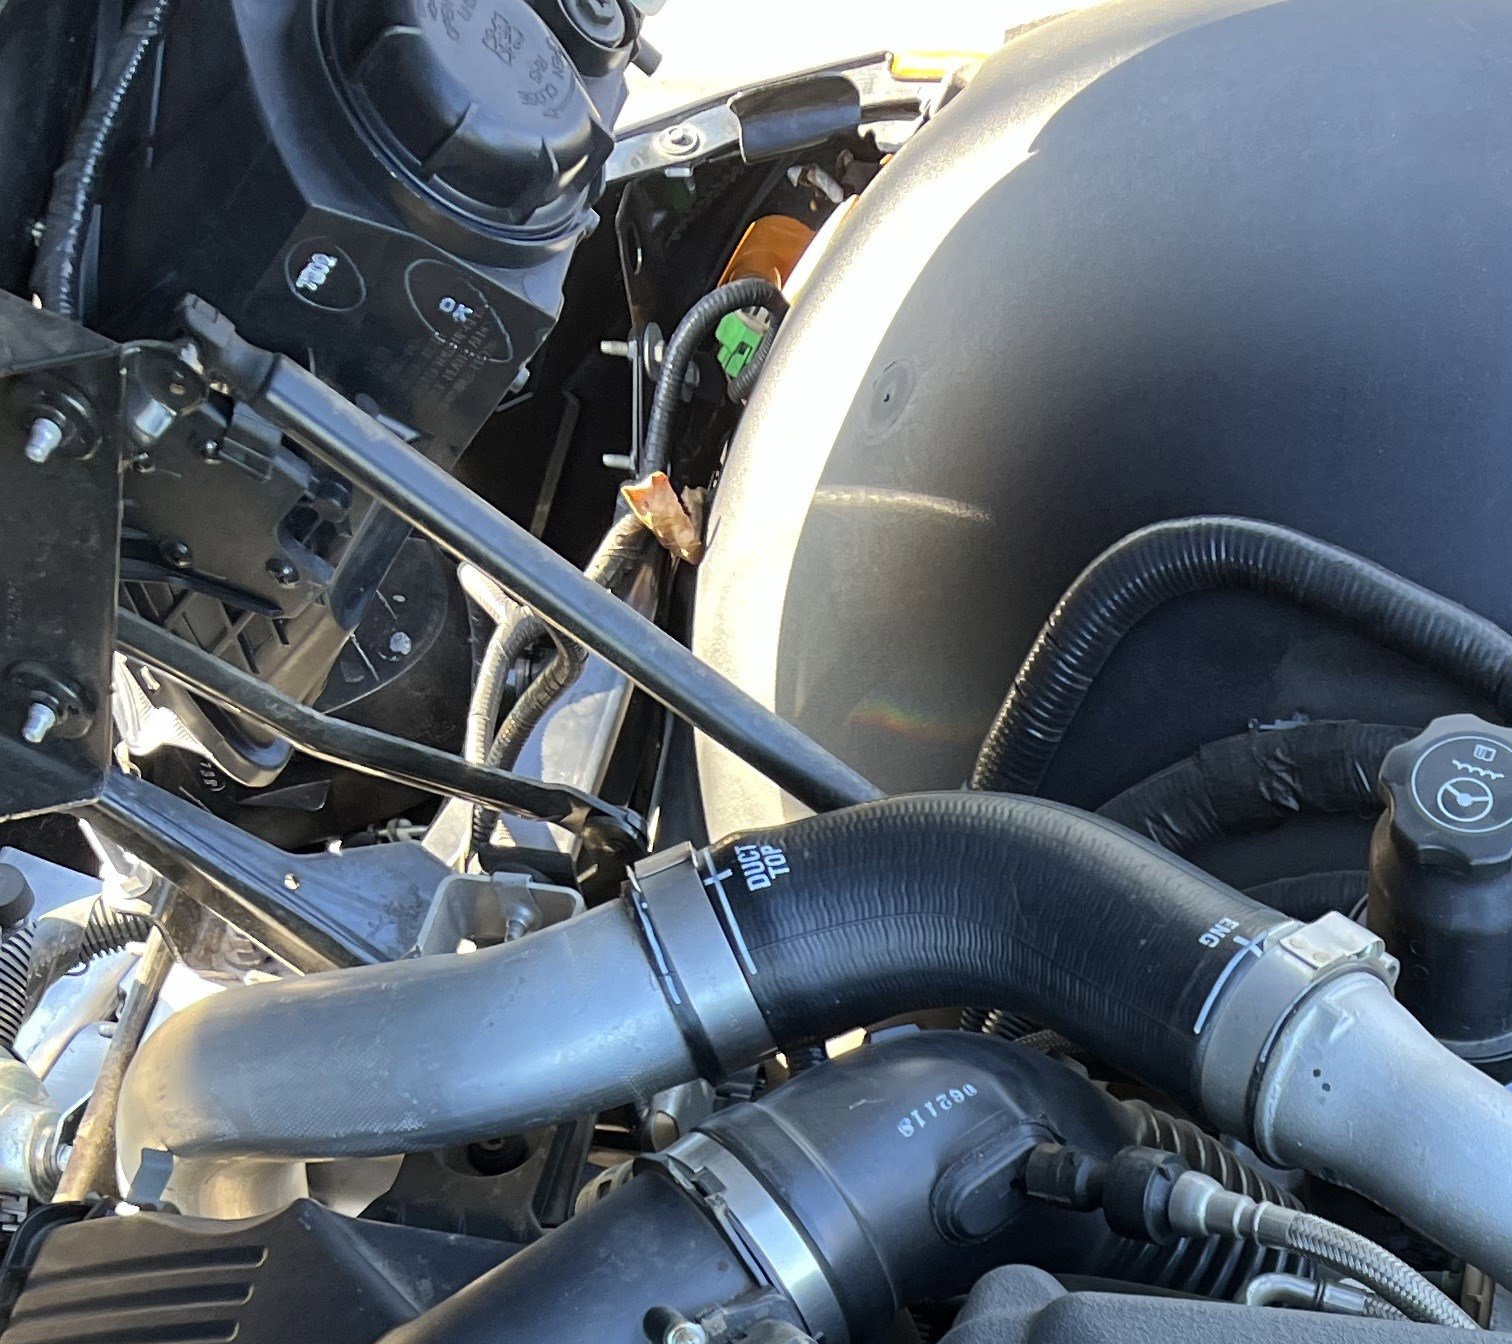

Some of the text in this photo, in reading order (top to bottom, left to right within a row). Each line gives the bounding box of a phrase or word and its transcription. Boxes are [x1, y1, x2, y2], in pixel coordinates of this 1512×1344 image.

[438, 296, 474, 323] OK
[734, 845, 772, 892] DUCT
[760, 845, 791, 880] TOP
[1199, 915, 1240, 949] ENG
